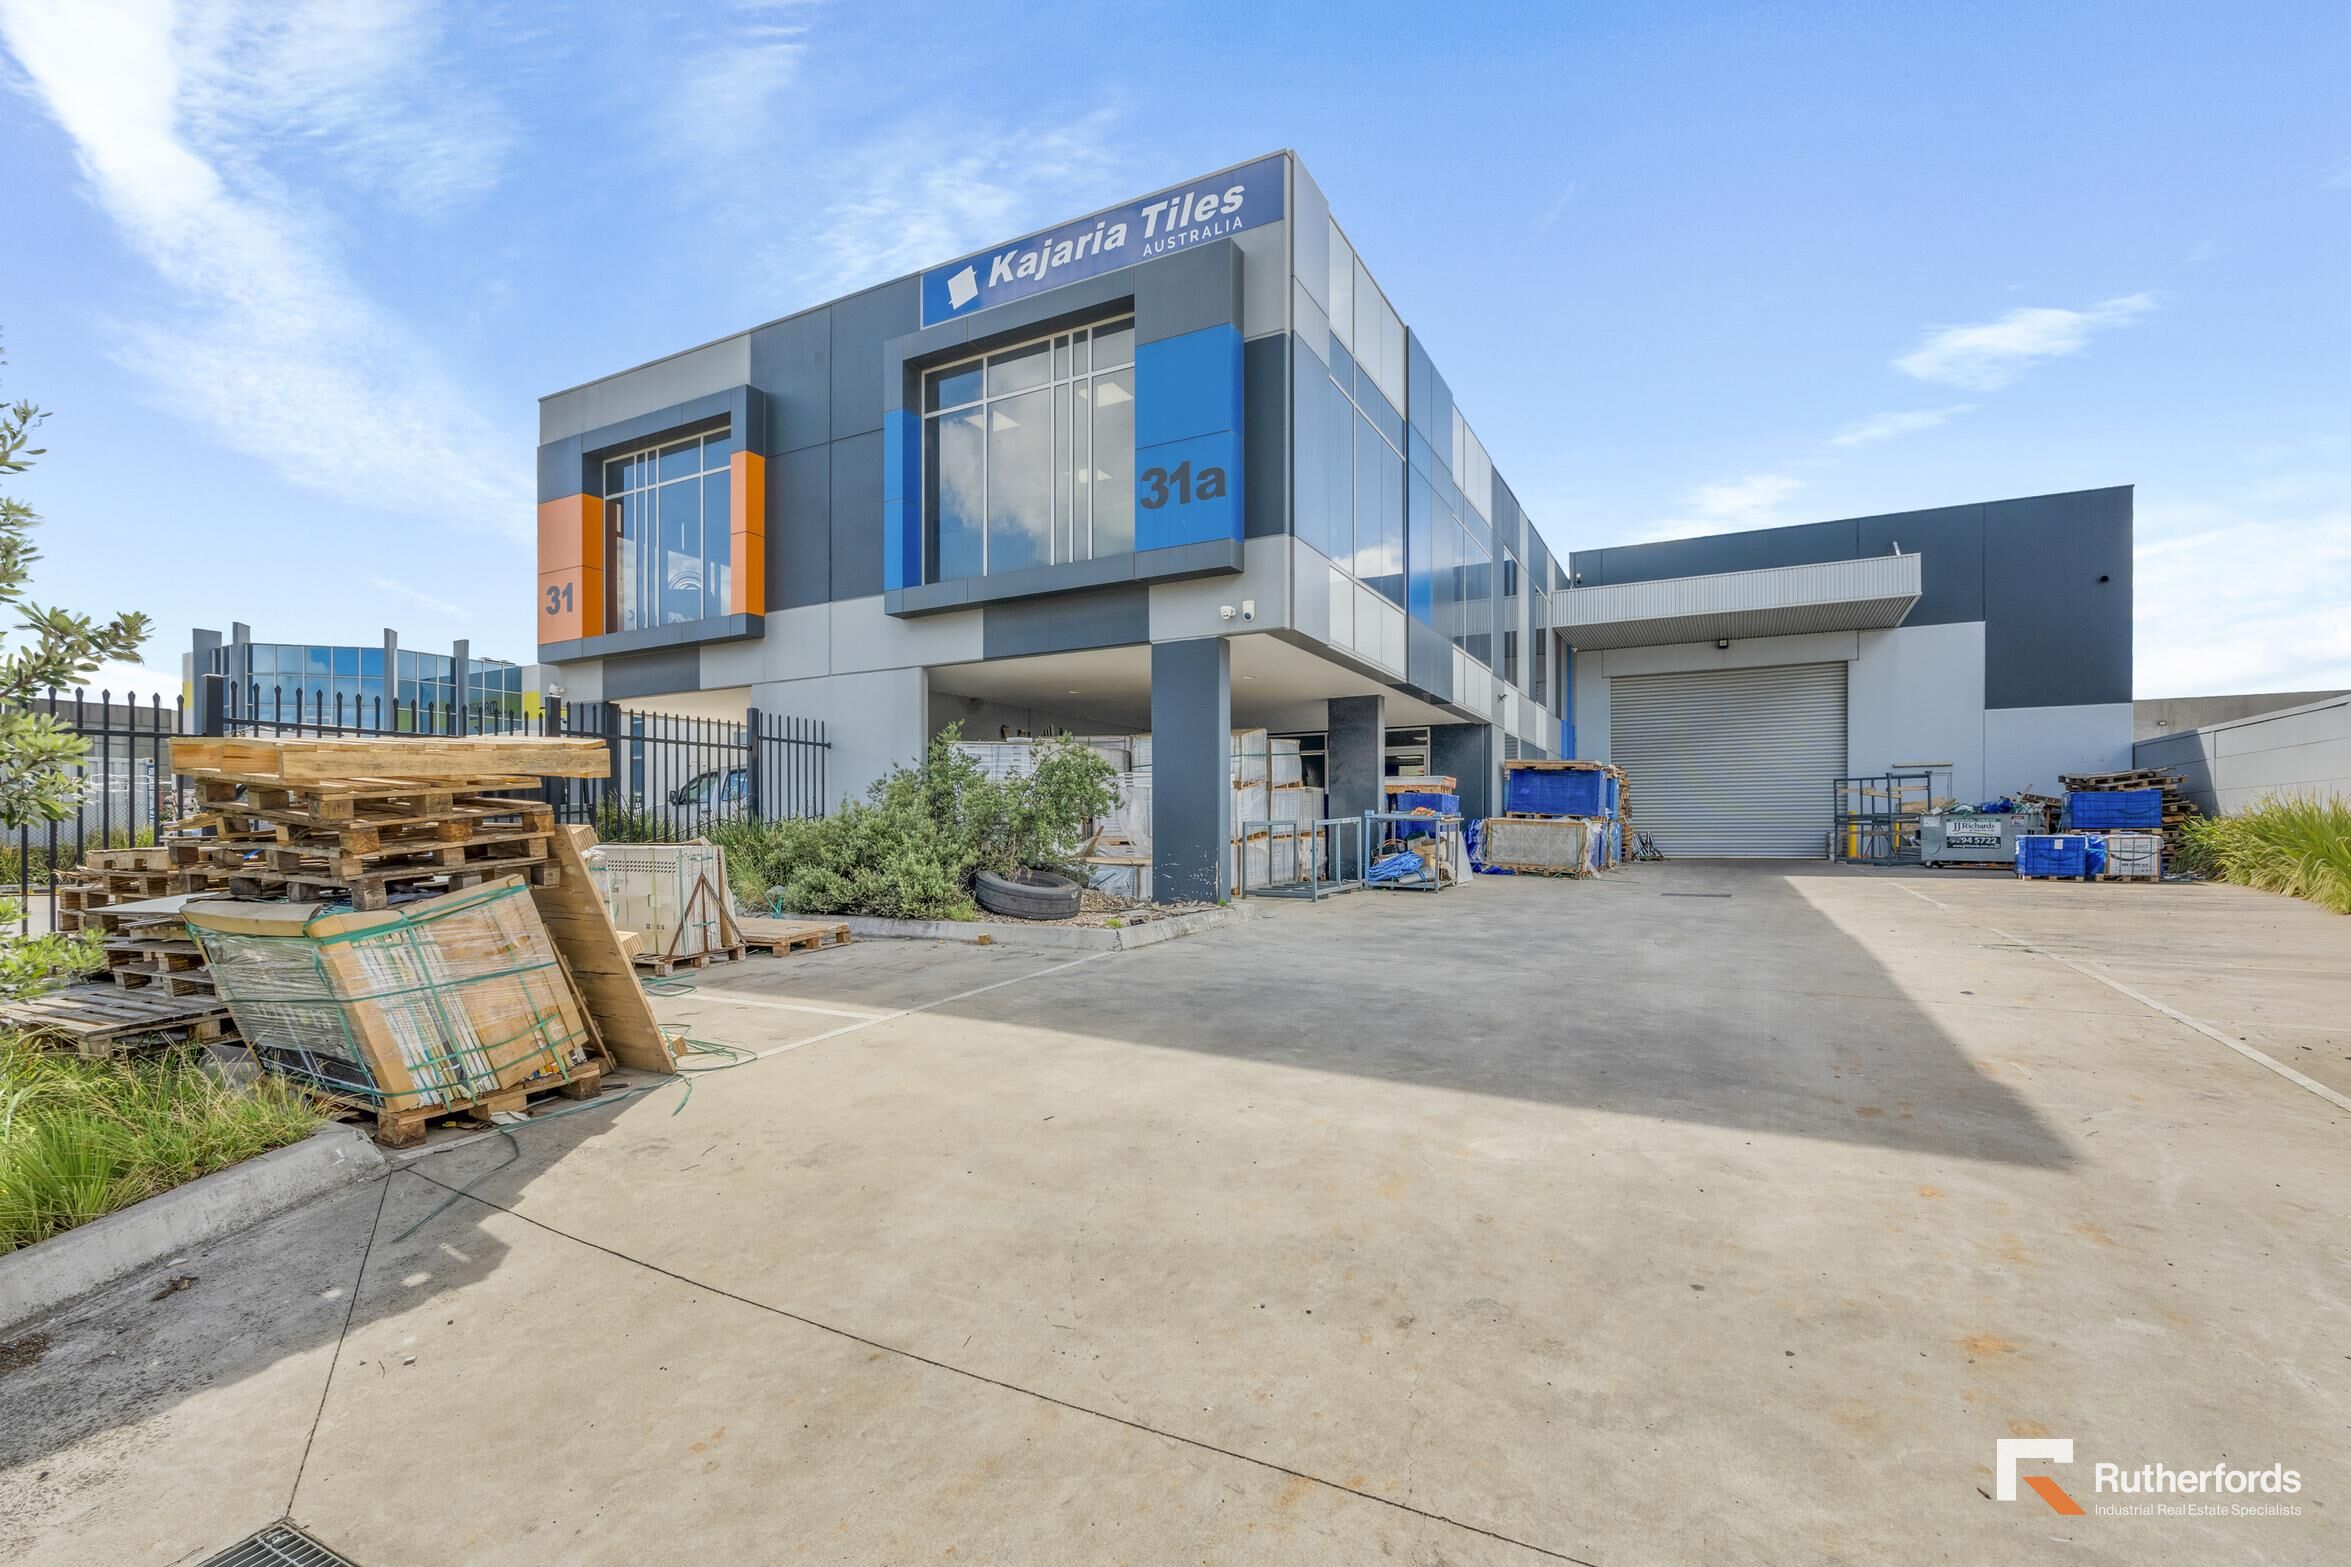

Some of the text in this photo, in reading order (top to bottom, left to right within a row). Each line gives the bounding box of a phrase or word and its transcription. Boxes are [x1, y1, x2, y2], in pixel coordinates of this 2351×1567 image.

[988, 185, 1245, 288] Kajaria Tiles
[1142, 216, 1244, 257] AUSTRALIA
[1140, 461, 1226, 509] 31a
[546, 582, 573, 615] 31
[1952, 822, 1961, 832] JJ
